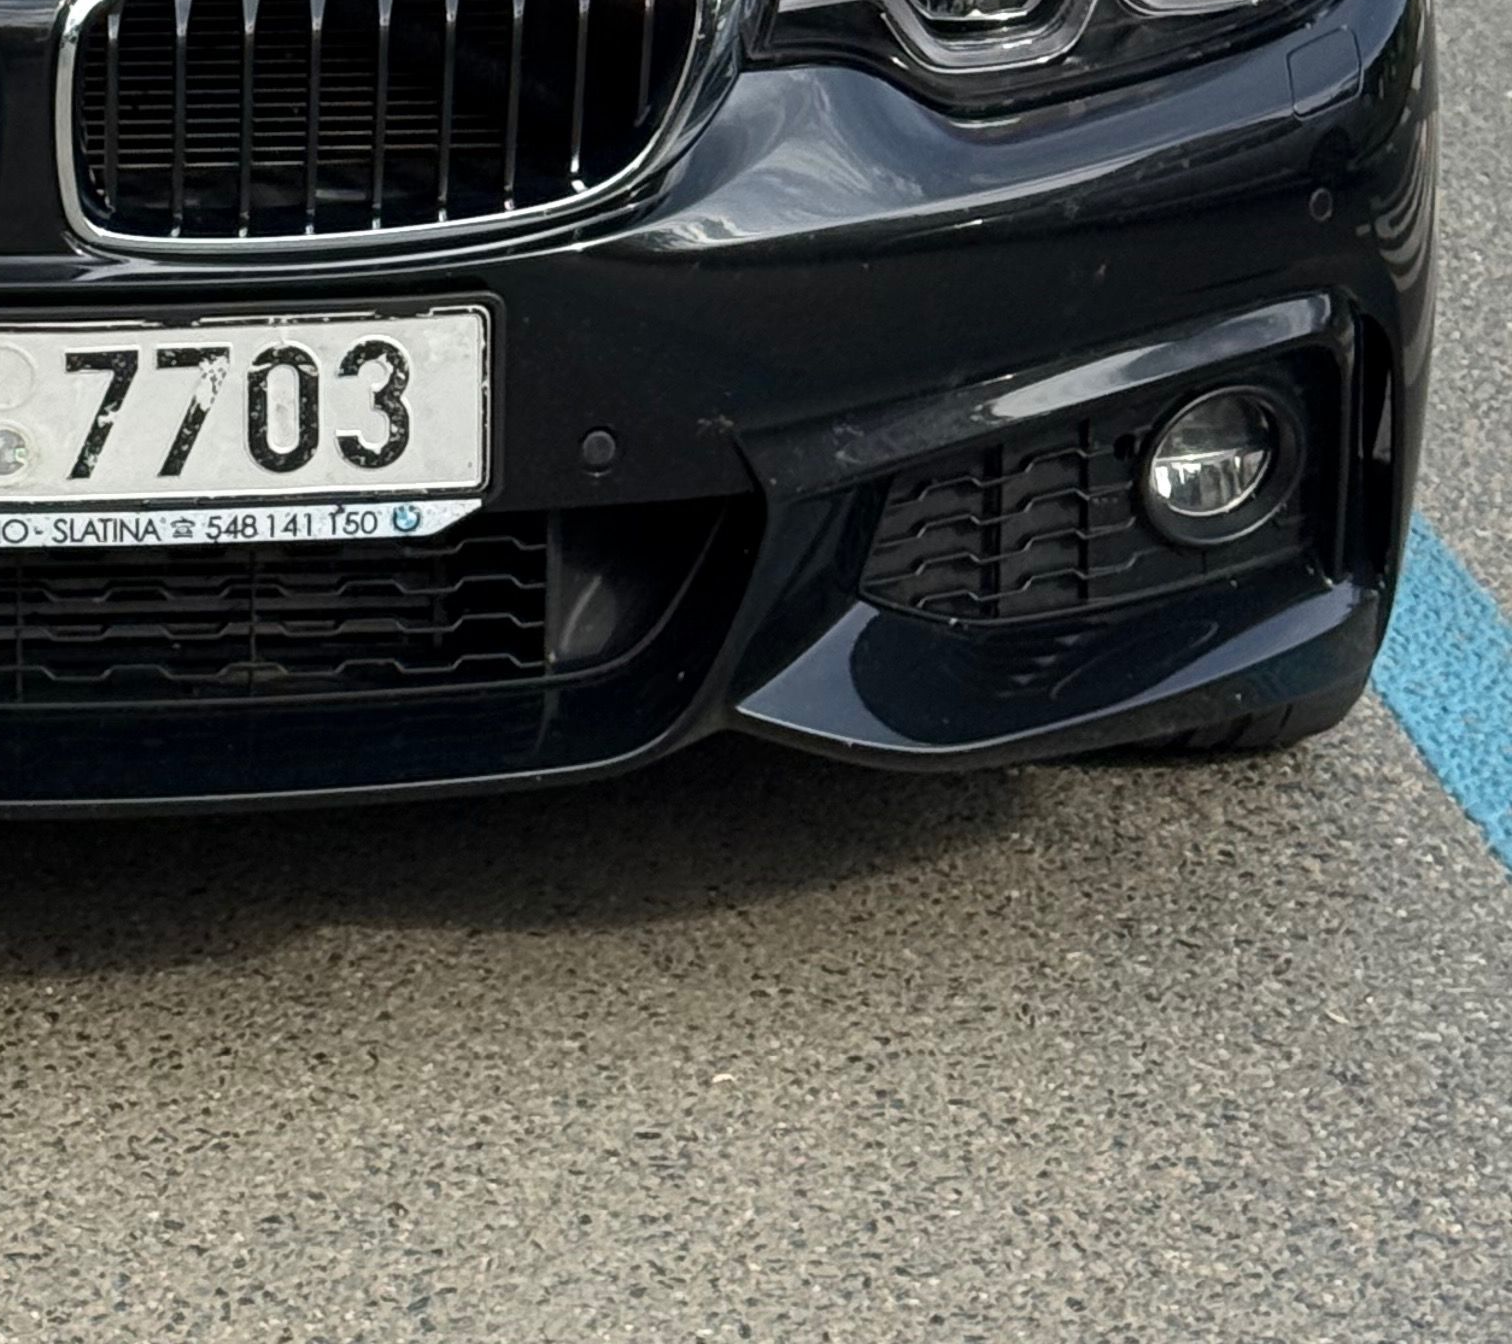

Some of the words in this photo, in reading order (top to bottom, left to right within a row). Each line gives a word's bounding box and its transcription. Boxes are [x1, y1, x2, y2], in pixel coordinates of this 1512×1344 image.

[64, 339, 411, 480] 7703
[205, 514, 258, 540] 548
[266, 512, 312, 538] 141
[327, 510, 379, 536] 150
